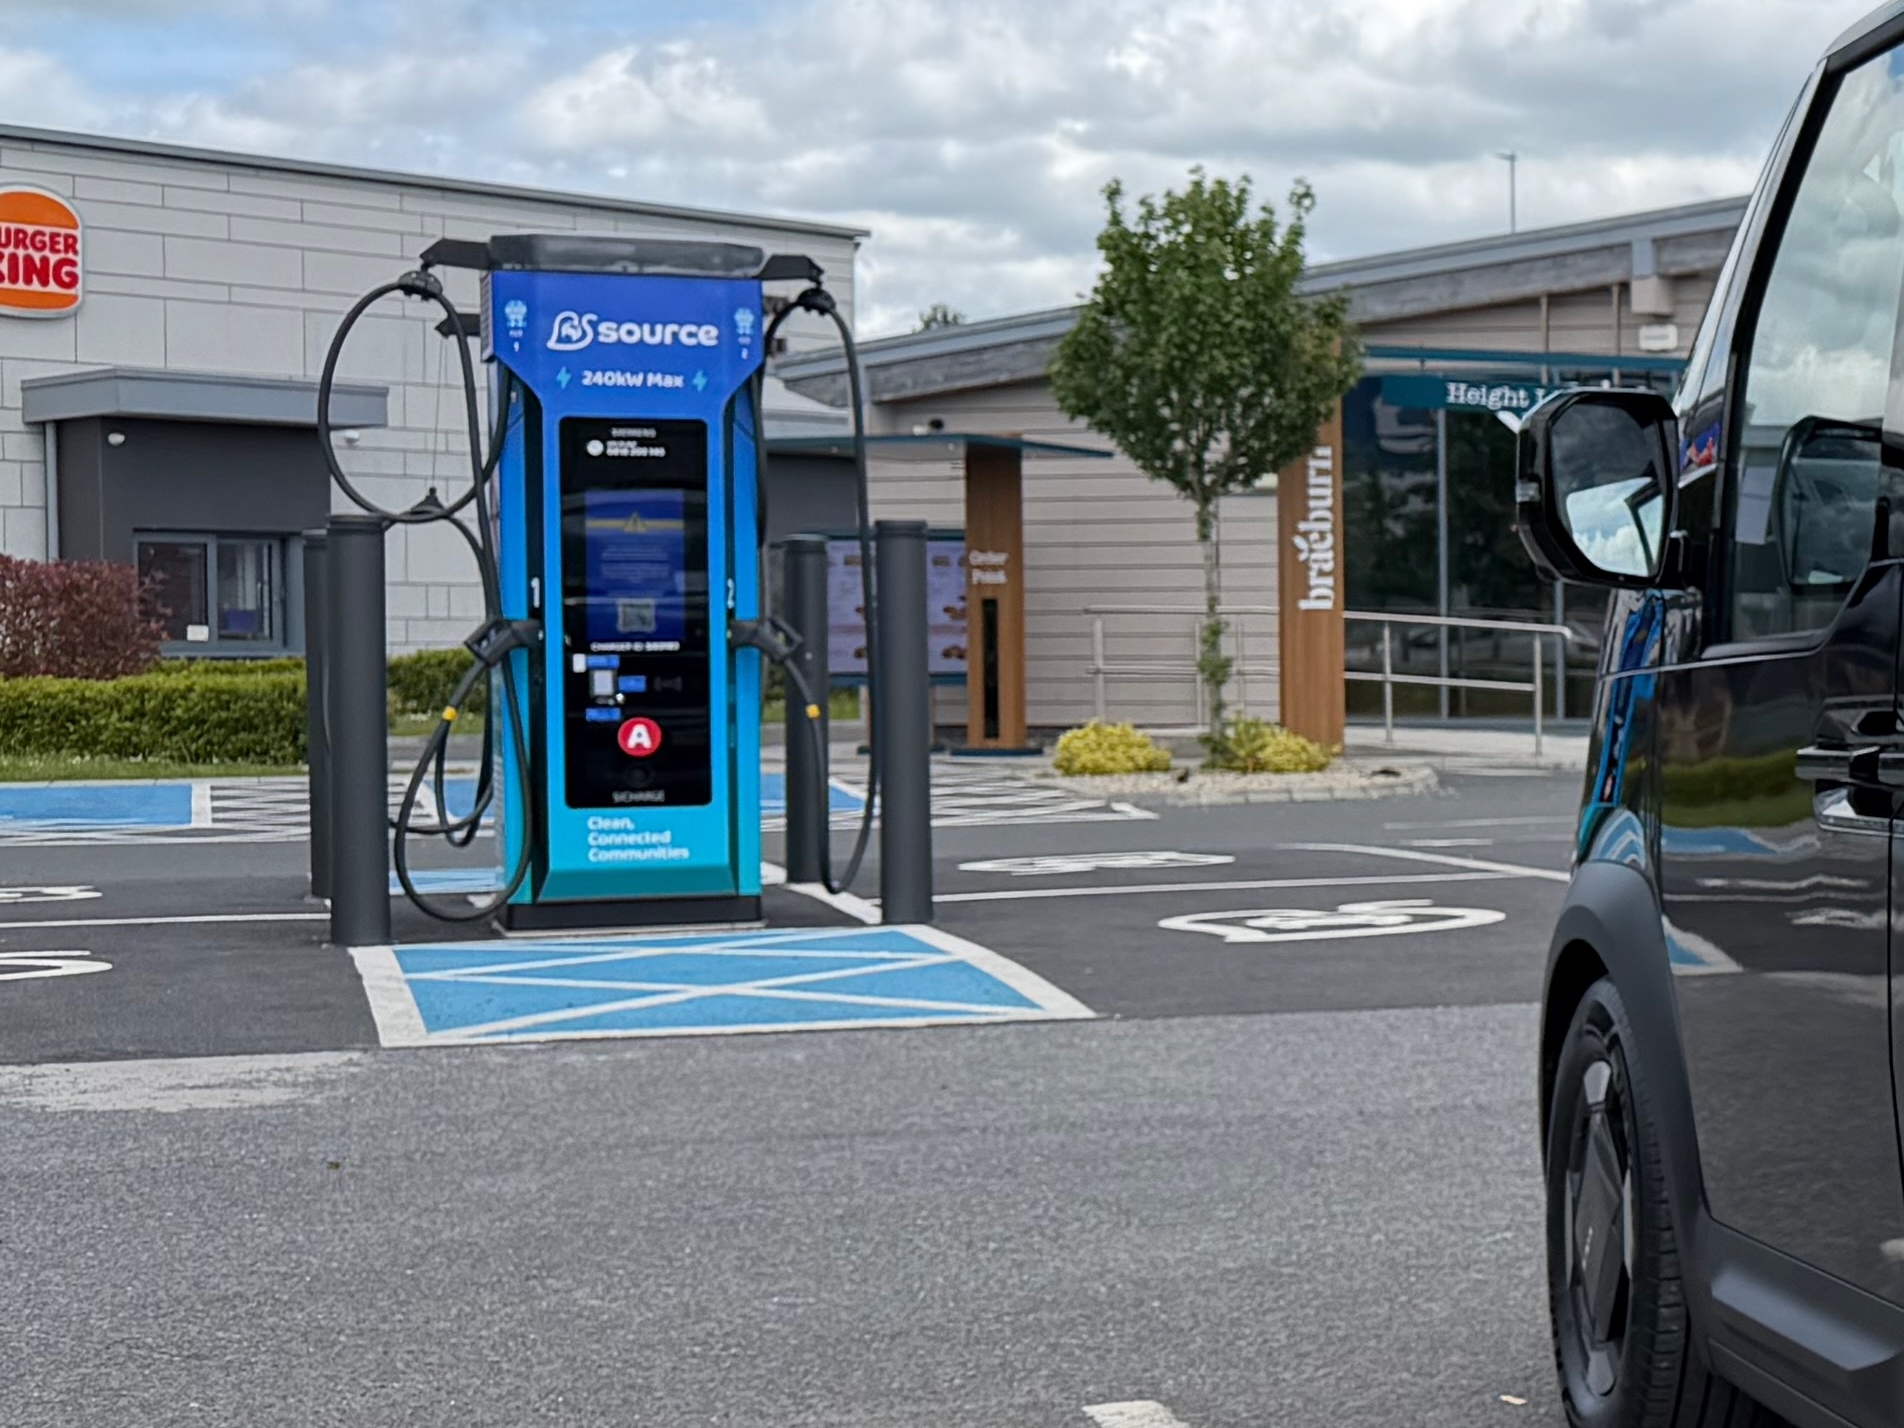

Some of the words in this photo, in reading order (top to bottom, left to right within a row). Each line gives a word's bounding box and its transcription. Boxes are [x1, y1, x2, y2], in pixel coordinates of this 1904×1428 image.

[0, 226, 79, 256] URGER
[598, 321, 719, 346] source
[582, 370, 644, 387] 240kW
[646, 372, 684, 388] Max
[1446, 381, 1530, 410] Height
[1293, 445, 1335, 610] braeburn
[531, 577, 540, 608] 1
[627, 724, 652, 749] A
[587, 816, 635, 831] Clean,
[588, 830, 672, 846] Connected
[588, 845, 690, 862] Communities
